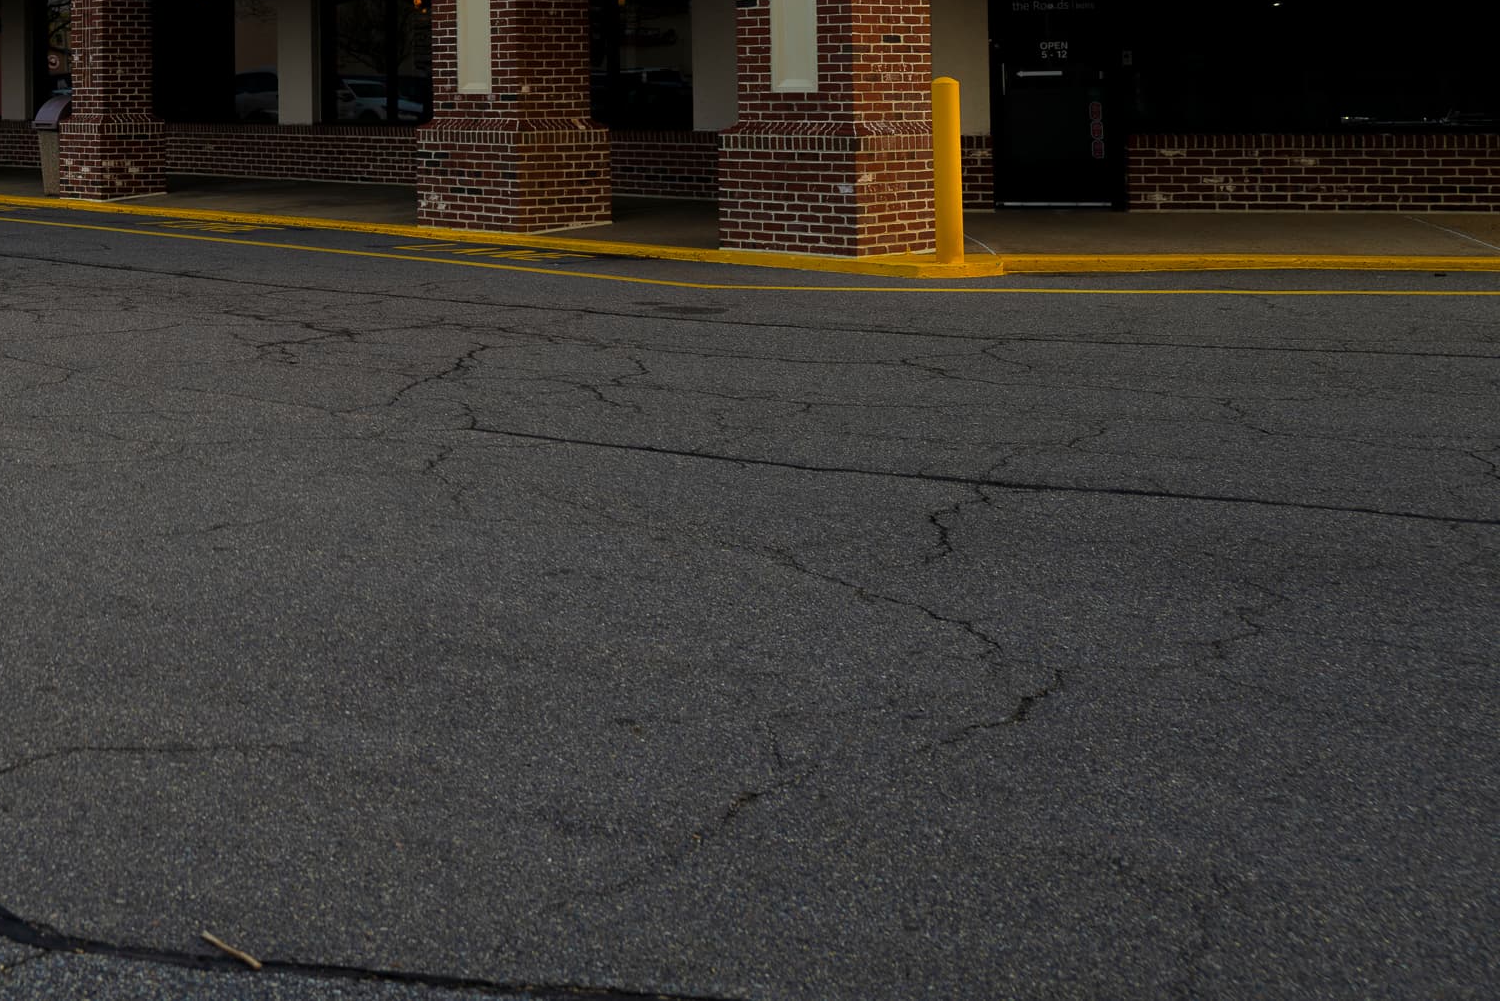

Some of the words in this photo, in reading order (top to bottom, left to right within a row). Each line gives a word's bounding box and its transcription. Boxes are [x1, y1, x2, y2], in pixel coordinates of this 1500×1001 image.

[1039, 41, 1068, 51] OPEN
[1041, 51, 1048, 59] 5
[1058, 51, 1068, 59] 12
